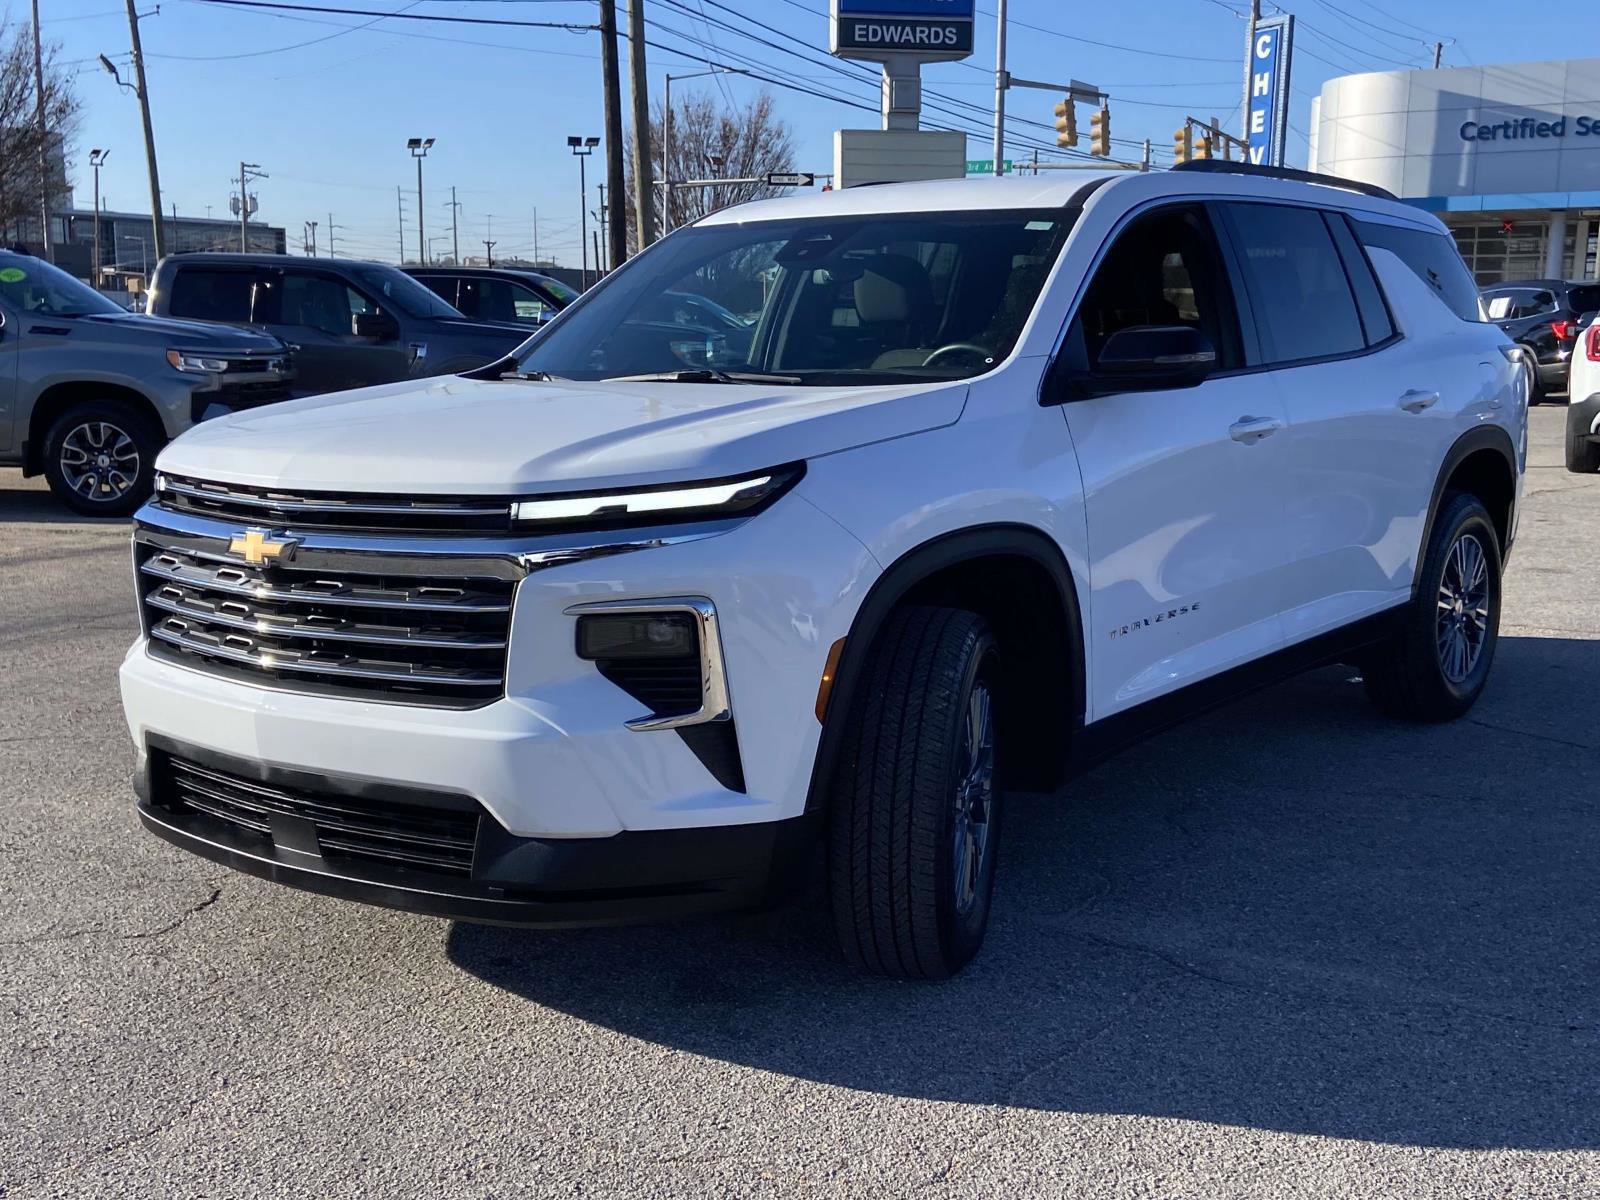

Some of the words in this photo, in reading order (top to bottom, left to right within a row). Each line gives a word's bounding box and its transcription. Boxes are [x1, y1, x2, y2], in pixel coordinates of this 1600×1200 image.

[854, 24, 957, 45] EDWARDS
[1460, 116, 1566, 142] Certified
[1109, 601, 1201, 640] TRAVERSE
